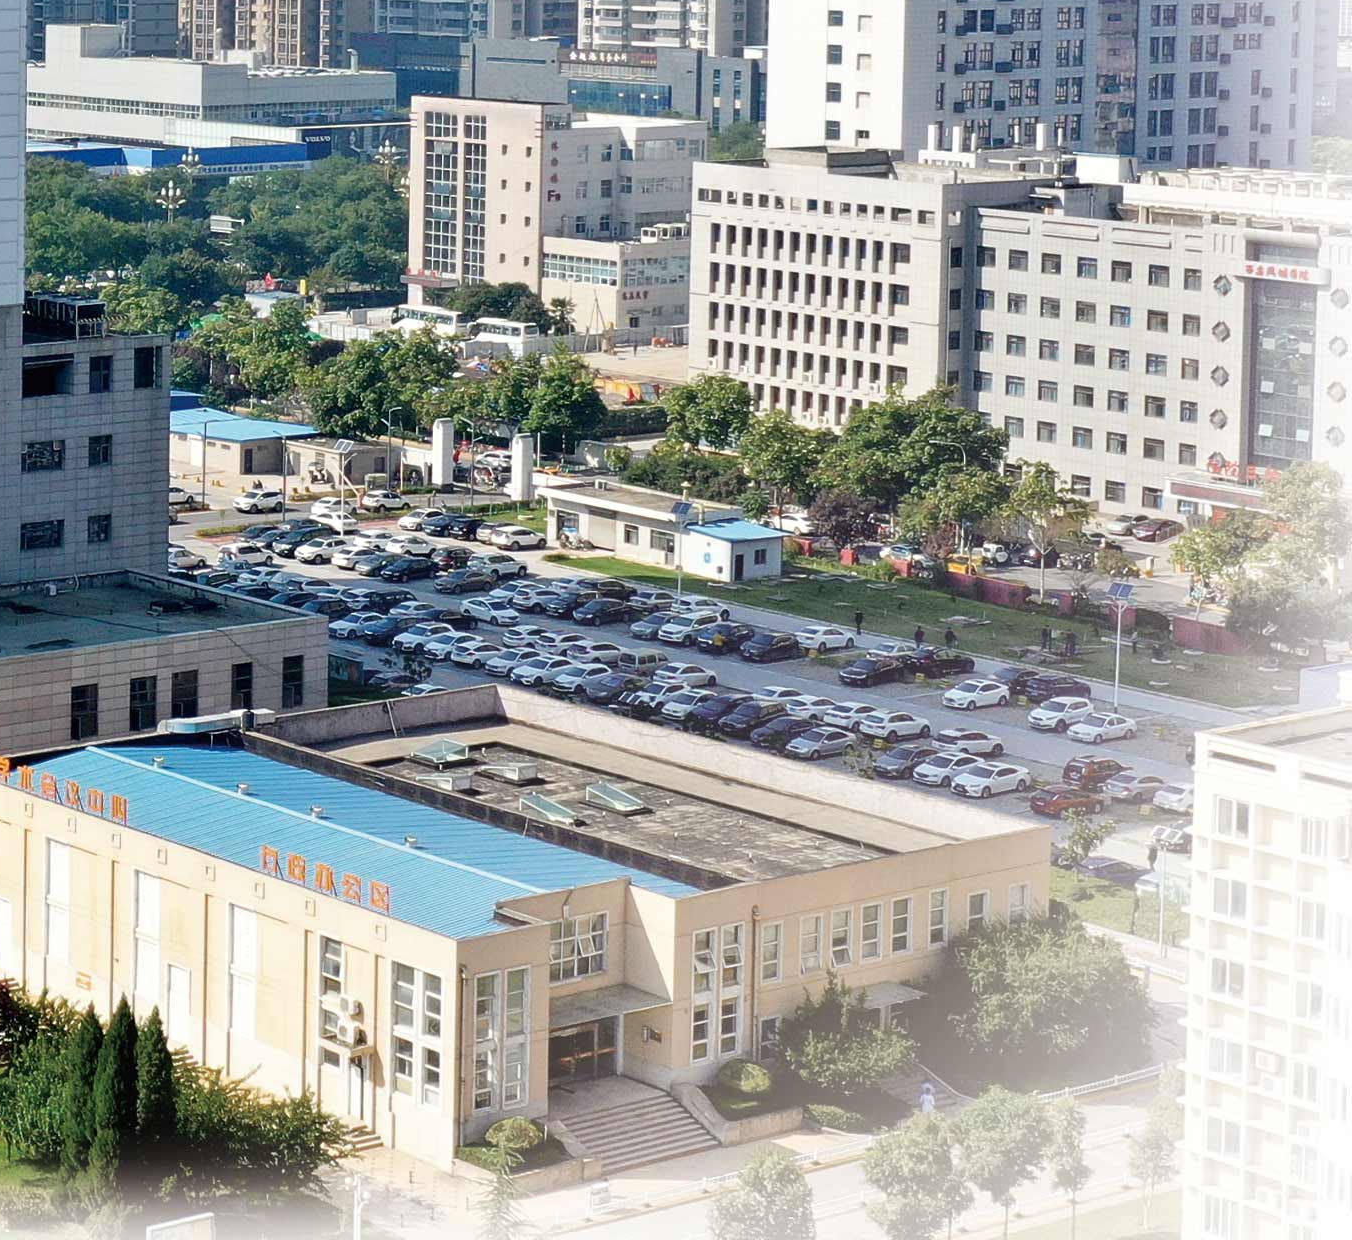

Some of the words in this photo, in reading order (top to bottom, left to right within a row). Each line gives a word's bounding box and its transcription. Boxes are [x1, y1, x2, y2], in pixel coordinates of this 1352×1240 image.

[261, 844, 391, 913] 行政办公区
